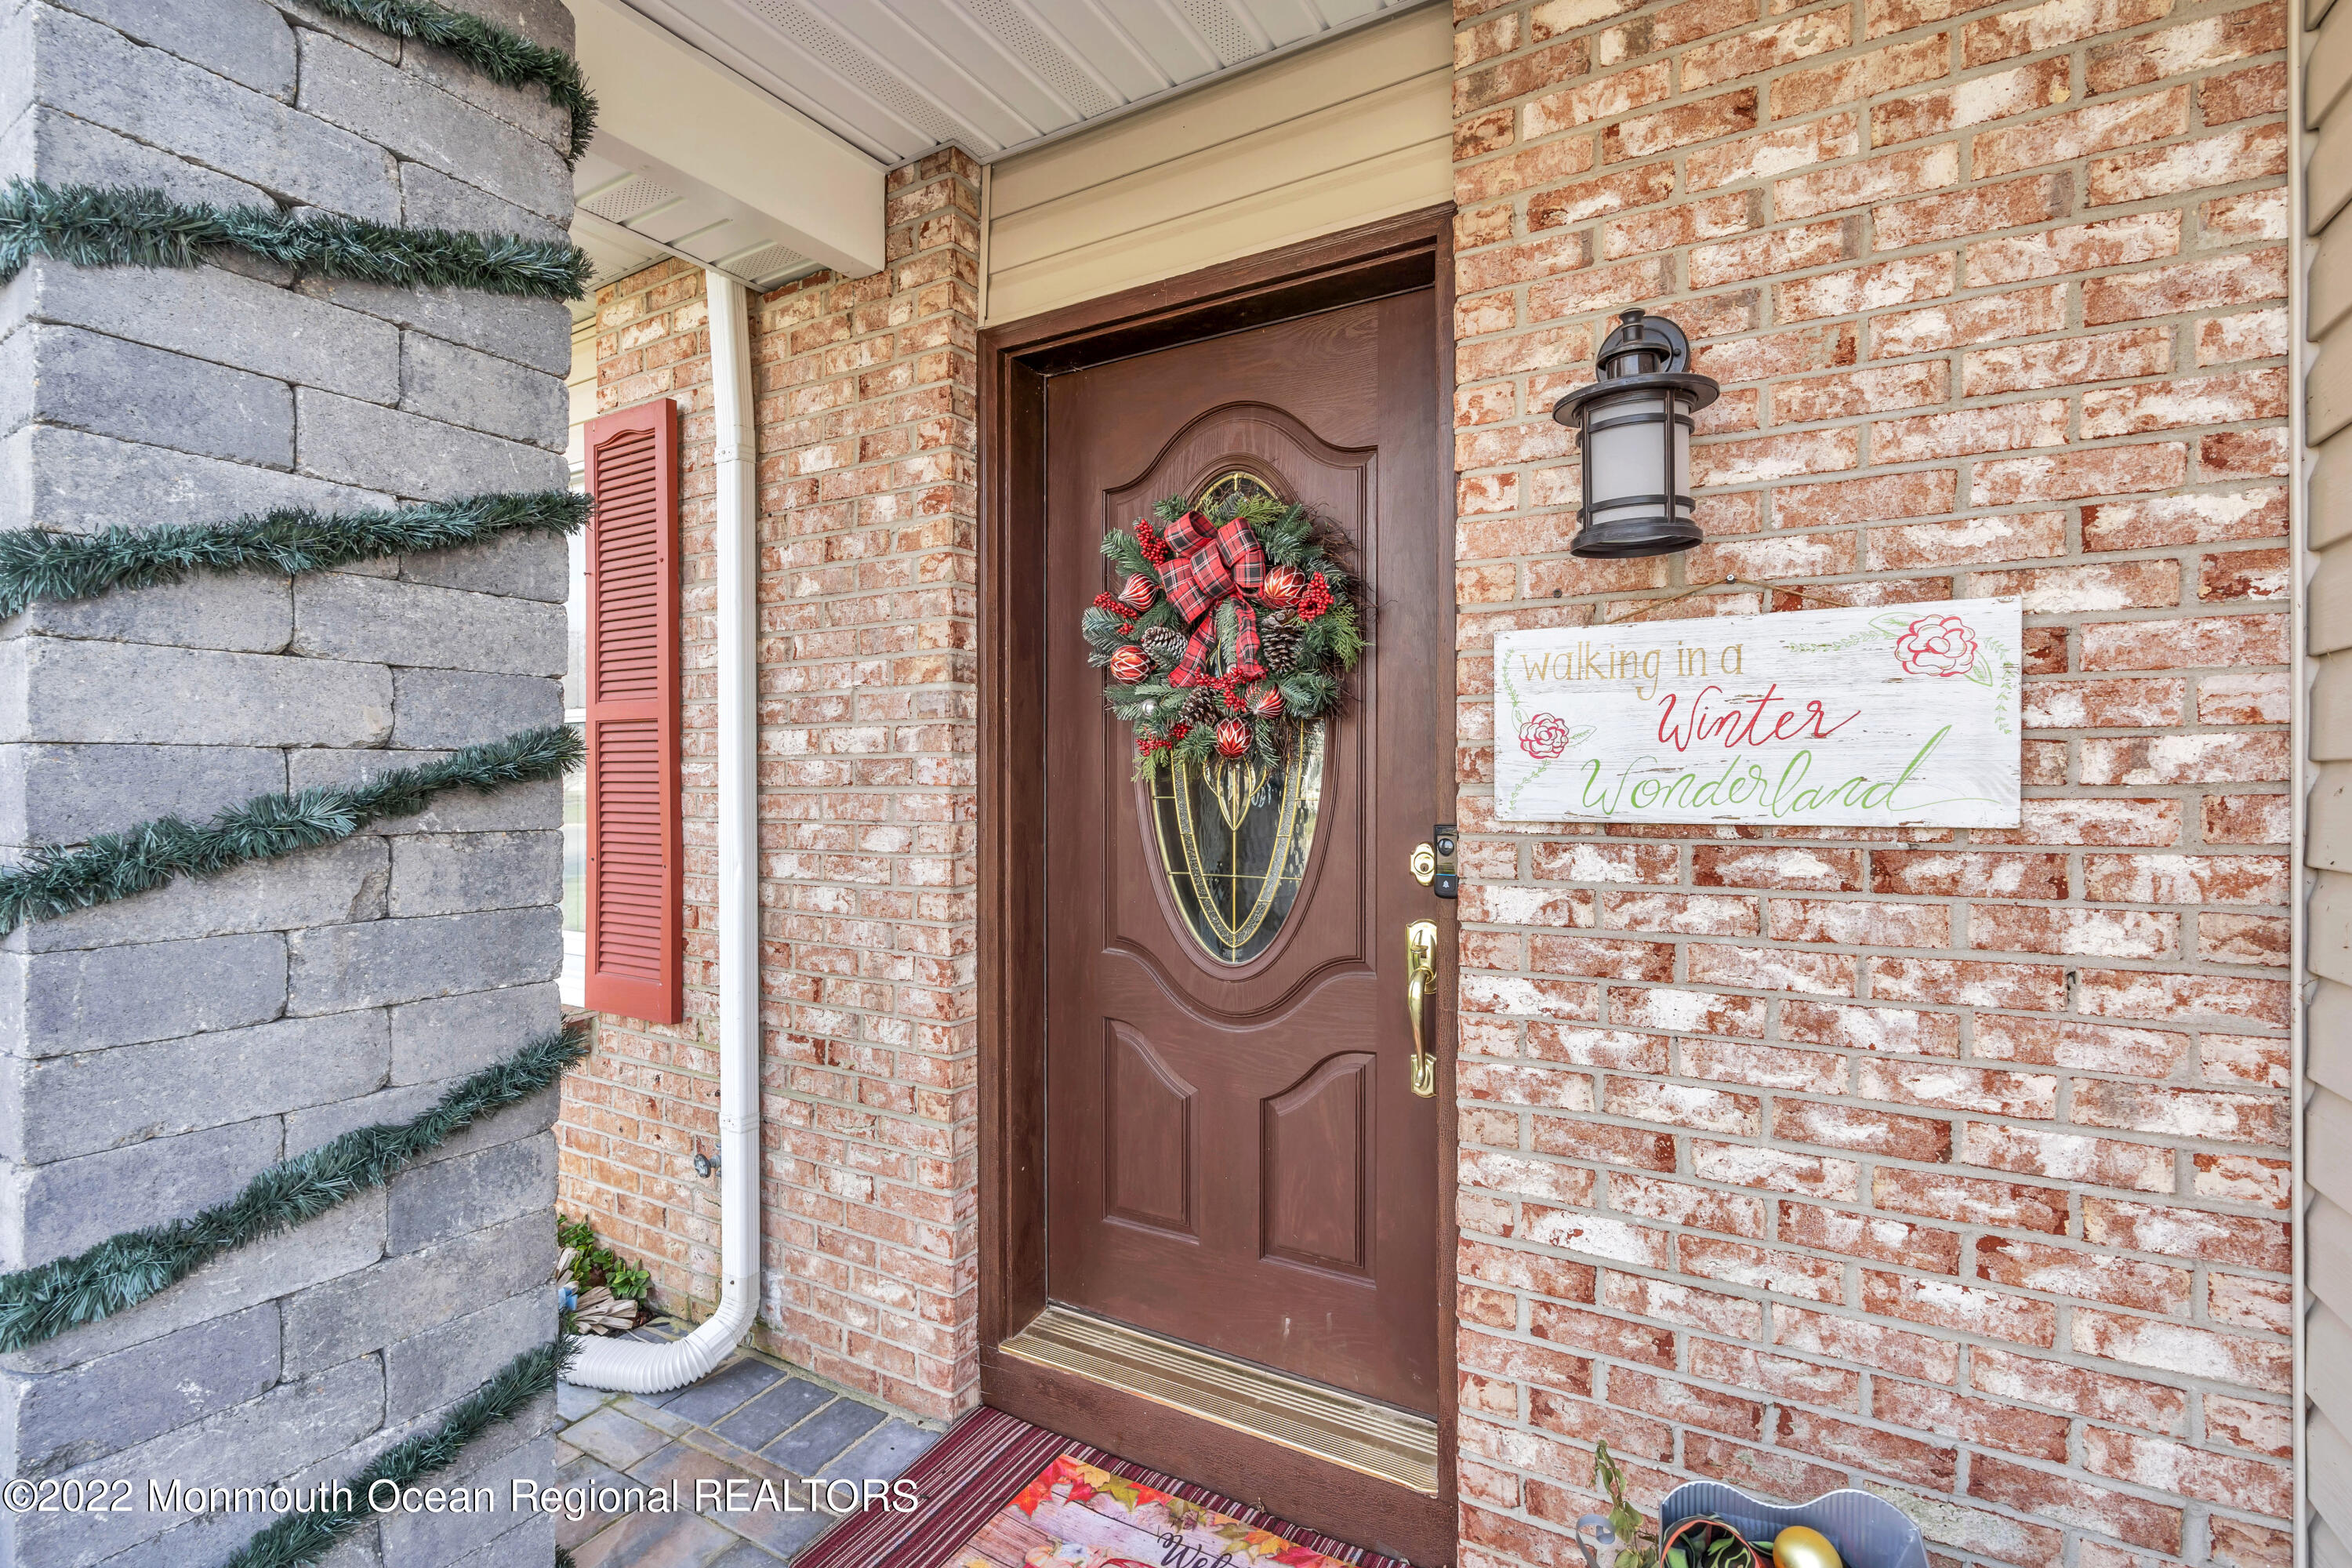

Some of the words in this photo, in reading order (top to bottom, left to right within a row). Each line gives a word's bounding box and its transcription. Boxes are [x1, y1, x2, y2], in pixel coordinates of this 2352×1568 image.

[1520, 641, 1661, 700] walking
[1677, 641, 1708, 677] in
[1721, 643, 1744, 675] a
[1658, 684, 1861, 752] Winter
[1581, 724, 2001, 818] Wonderland
